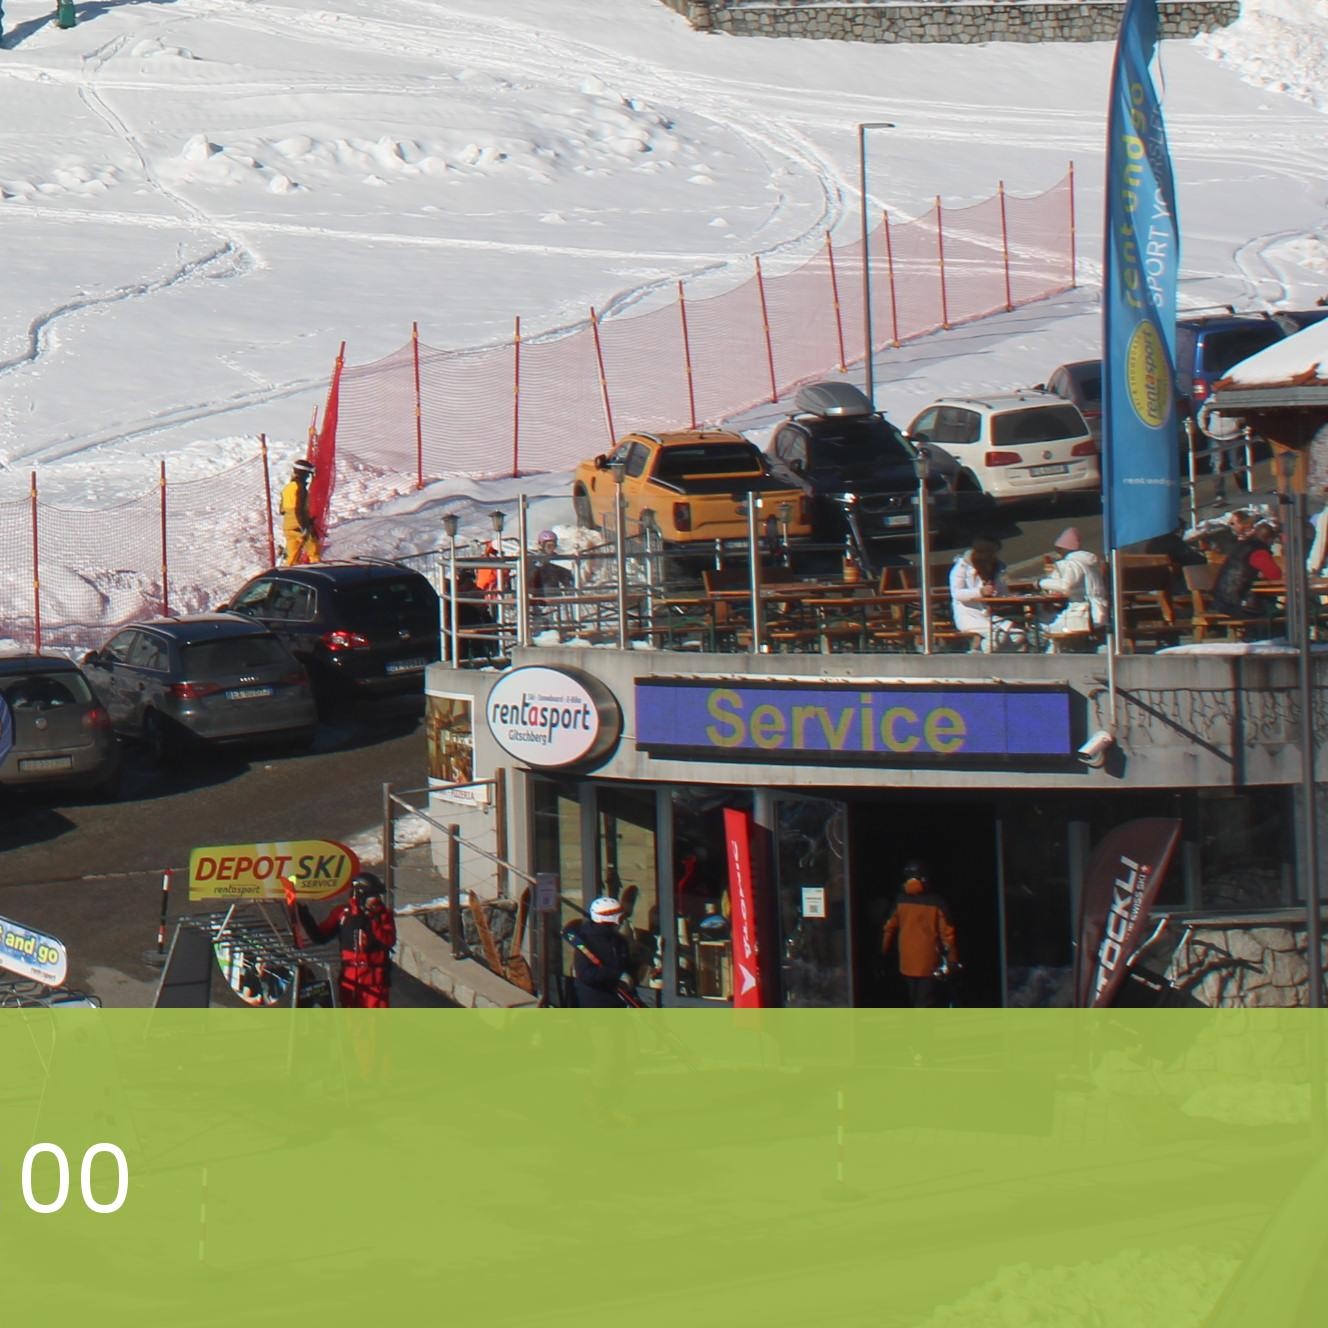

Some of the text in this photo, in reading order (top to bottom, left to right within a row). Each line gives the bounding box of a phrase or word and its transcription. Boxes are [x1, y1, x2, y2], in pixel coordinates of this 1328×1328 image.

[1146, 224, 1170, 308] SPORT
[1143, 329, 1160, 419] rentasport
[493, 693, 591, 743] rentasport
[508, 729, 547, 745] Gitschberg
[705, 687, 967, 753] Service
[195, 854, 347, 881] DEPOT SKI
[214, 884, 261, 897] rentasport
[302, 878, 338, 888] SERVICE
[5, 932, 36, 955] and
[37, 944, 60, 964] go
